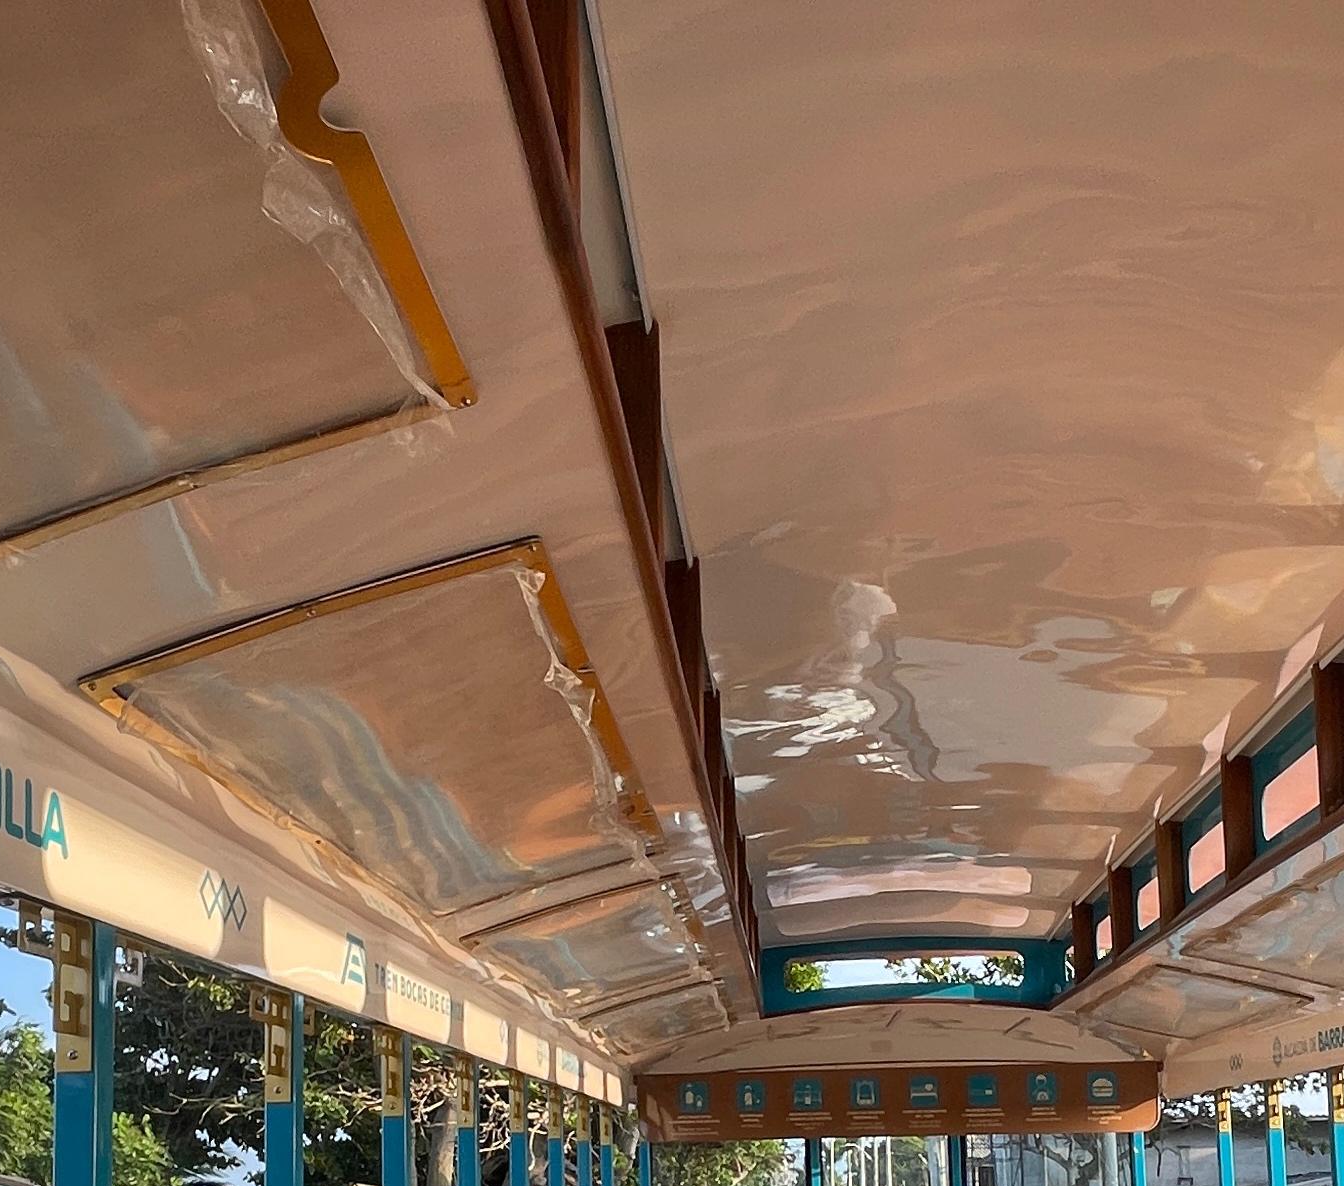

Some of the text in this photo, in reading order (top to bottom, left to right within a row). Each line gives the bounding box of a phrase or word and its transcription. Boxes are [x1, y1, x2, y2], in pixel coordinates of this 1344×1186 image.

[374, 962, 398, 993] TREN
[400, 975, 428, 1007] BOCAS
[429, 990, 439, 1012] DE
